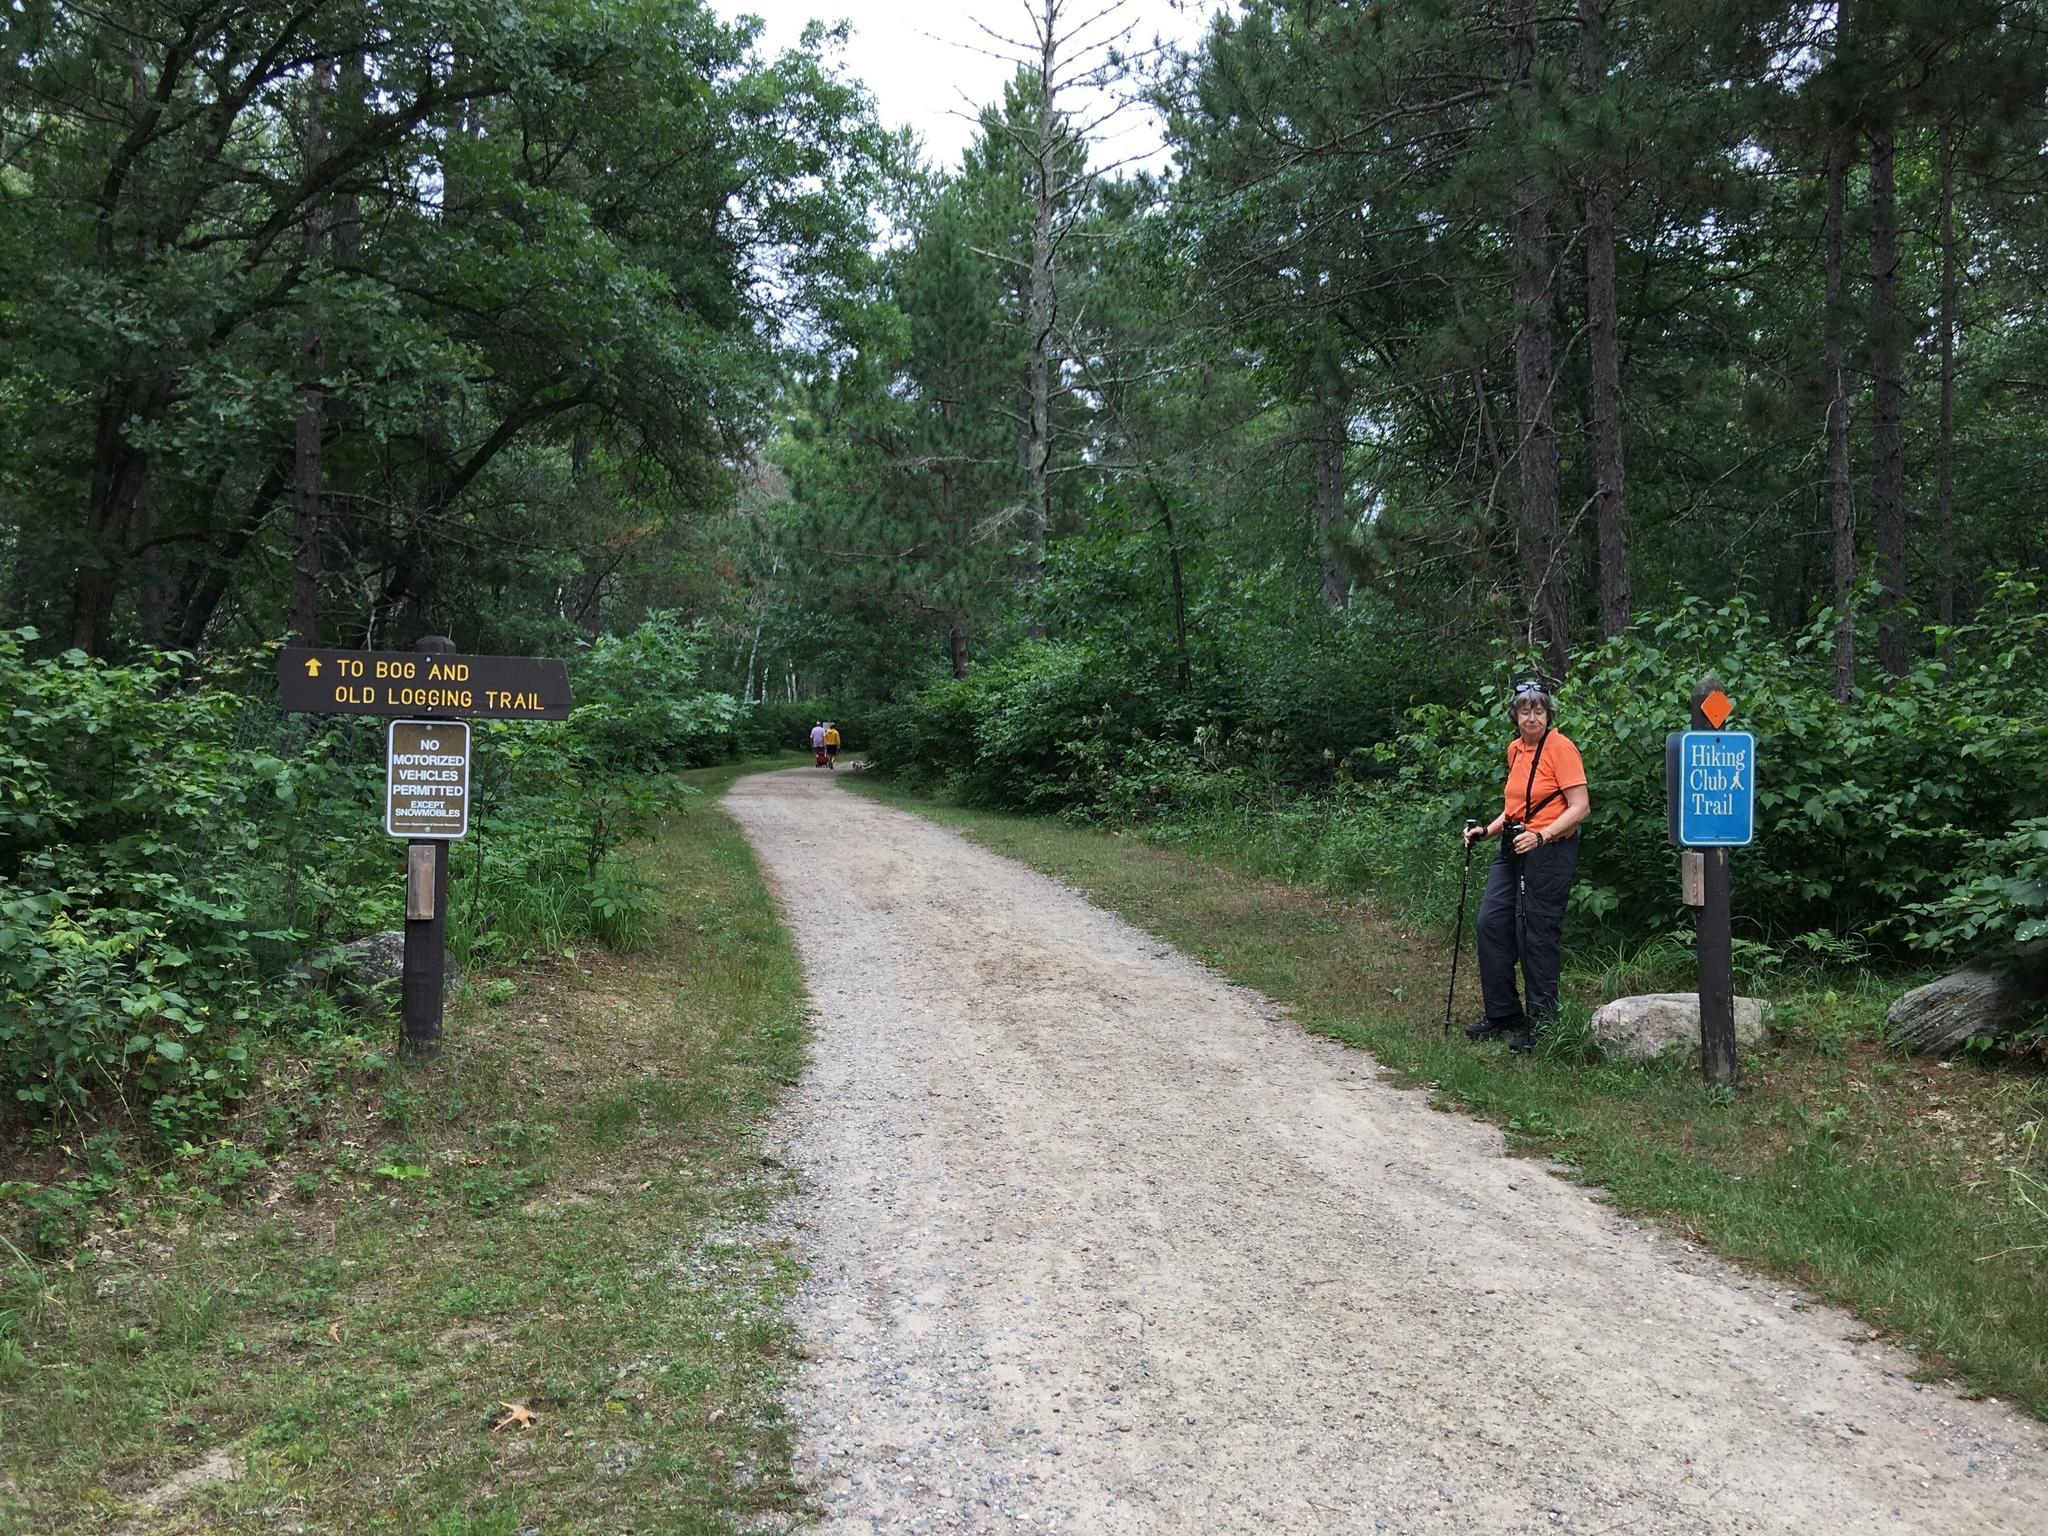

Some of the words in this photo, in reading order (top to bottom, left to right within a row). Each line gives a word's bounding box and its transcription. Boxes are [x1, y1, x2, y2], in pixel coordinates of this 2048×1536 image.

[337, 659, 364, 678] TO
[376, 661, 416, 679] BOG
[428, 663, 470, 682] AND
[335, 686, 375, 704] OLD
[388, 688, 473, 708] LOGGING
[485, 691, 545, 710] TRAIL
[420, 740, 440, 751] NO
[393, 754, 465, 767] MOTORIZED
[1691, 744, 1746, 771] Hiking
[399, 769, 459, 781] VEHICLES
[1690, 769, 1727, 791] Club
[393, 785, 464, 796] PERMITTED
[410, 800, 446, 809] EXCEPT
[1692, 793, 1733, 816] Trail
[395, 808, 460, 817] SNOWMOBILES
